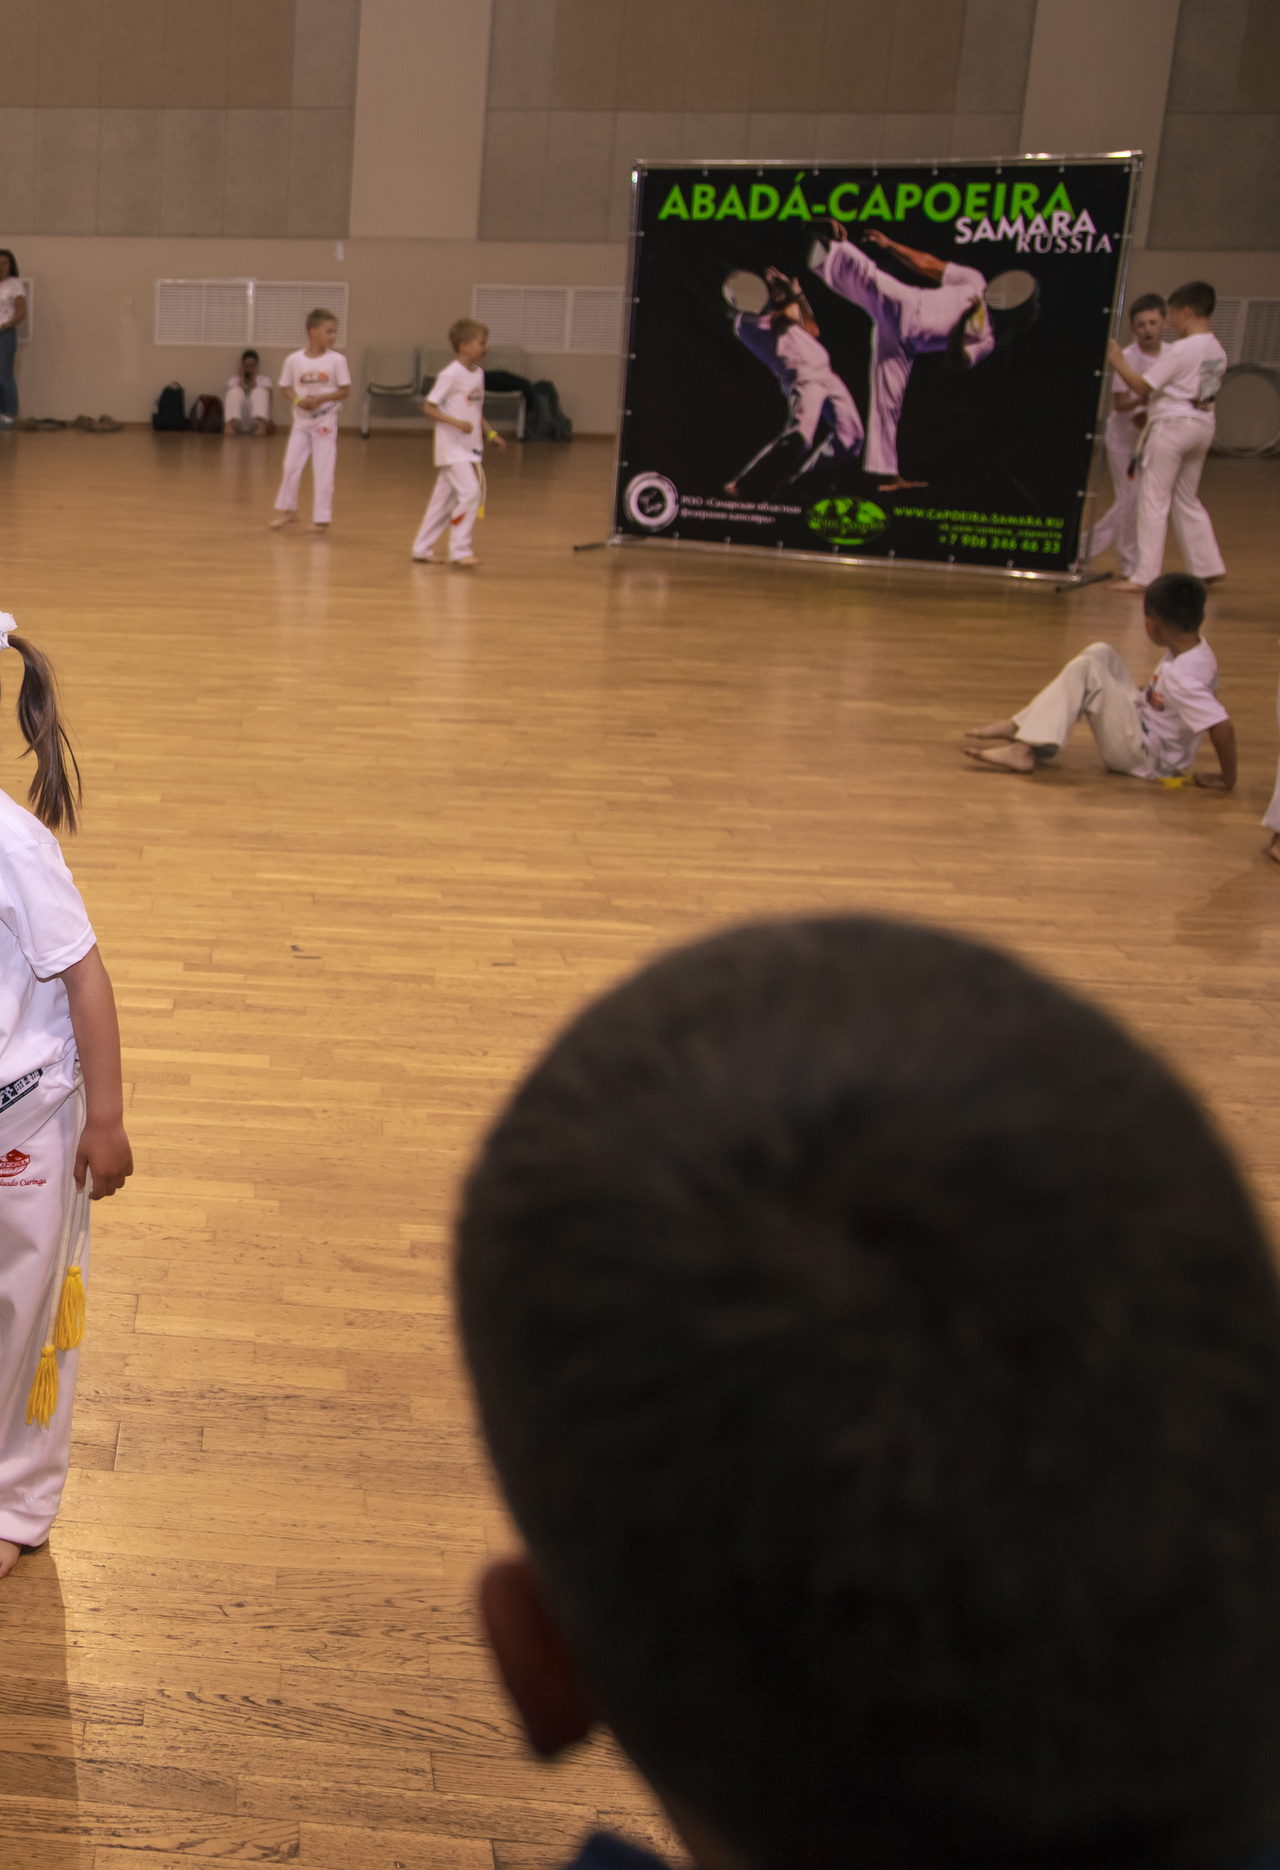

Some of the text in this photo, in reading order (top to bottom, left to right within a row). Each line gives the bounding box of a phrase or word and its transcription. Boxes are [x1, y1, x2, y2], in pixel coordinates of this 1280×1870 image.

[657, 171, 1077, 223] ABADÁ-CAPOEIRA
[954, 208, 1098, 245] SAMARA
[1016, 232, 1113, 254] RUSSIA
